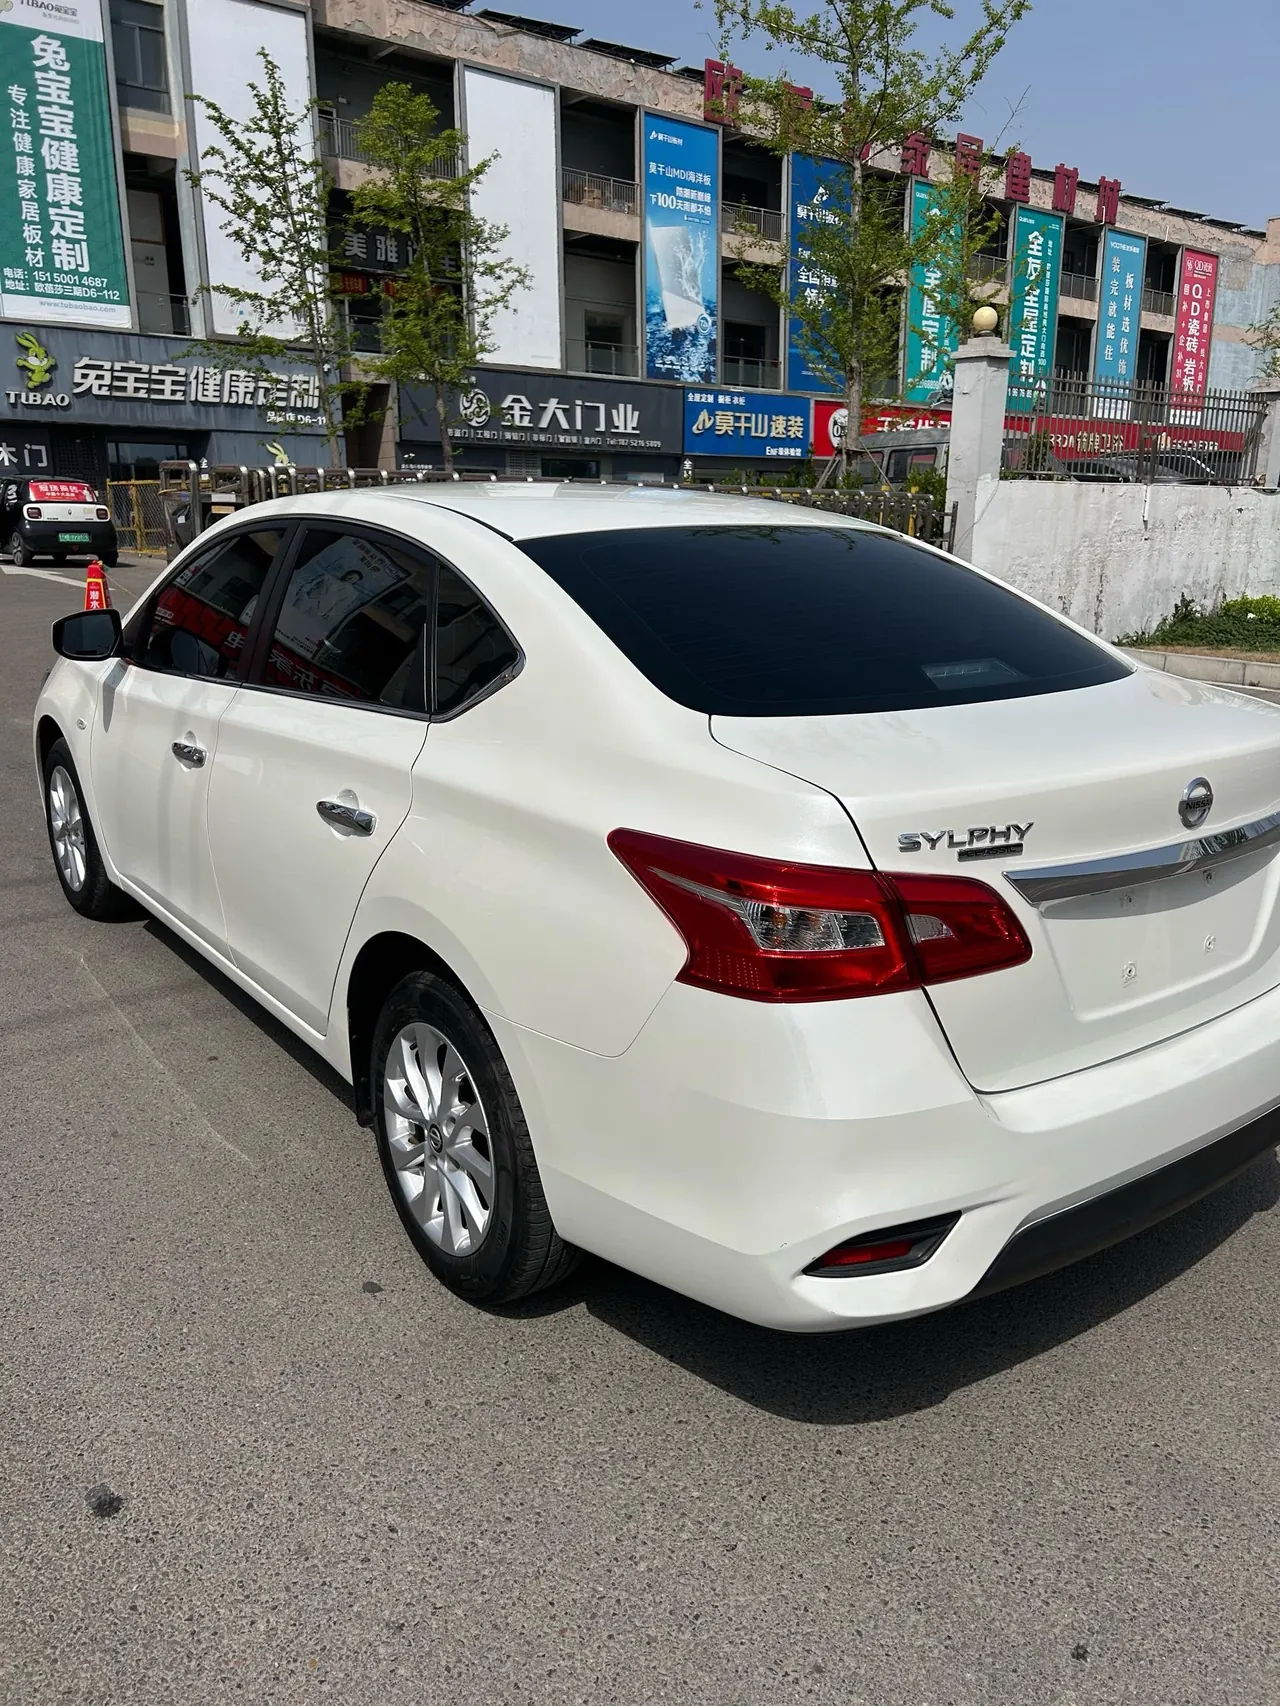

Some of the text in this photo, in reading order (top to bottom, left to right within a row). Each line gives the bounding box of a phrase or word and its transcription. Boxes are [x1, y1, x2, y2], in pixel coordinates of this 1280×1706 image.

[30, 34, 90, 273] 兔宝宝健康定制
[7, 83, 45, 268] 专注健康家居板材
[648, 161, 712, 187] 莫干山MDI海洋板
[33, 270, 51, 281] 151
[53, 273, 79, 285] 5001
[81, 276, 108, 288] 4687
[39, 300, 116, 313] www.tubaobao.com
[1019, 230, 1044, 383] 全友全屋定制
[1104, 255, 1121, 361] 装完就能住
[1185, 284, 1203, 354] QD瓷砖
[72, 356, 320, 409] 兔宝宝健康定制
[1182, 358, 1197, 392] 岩板
[501, 393, 641, 434] 金大门业
[687, 392, 714, 403] 全屋定制
[714, 410, 804, 439] 莫干山速装
[897, 821, 1035, 853] SYLPHY
